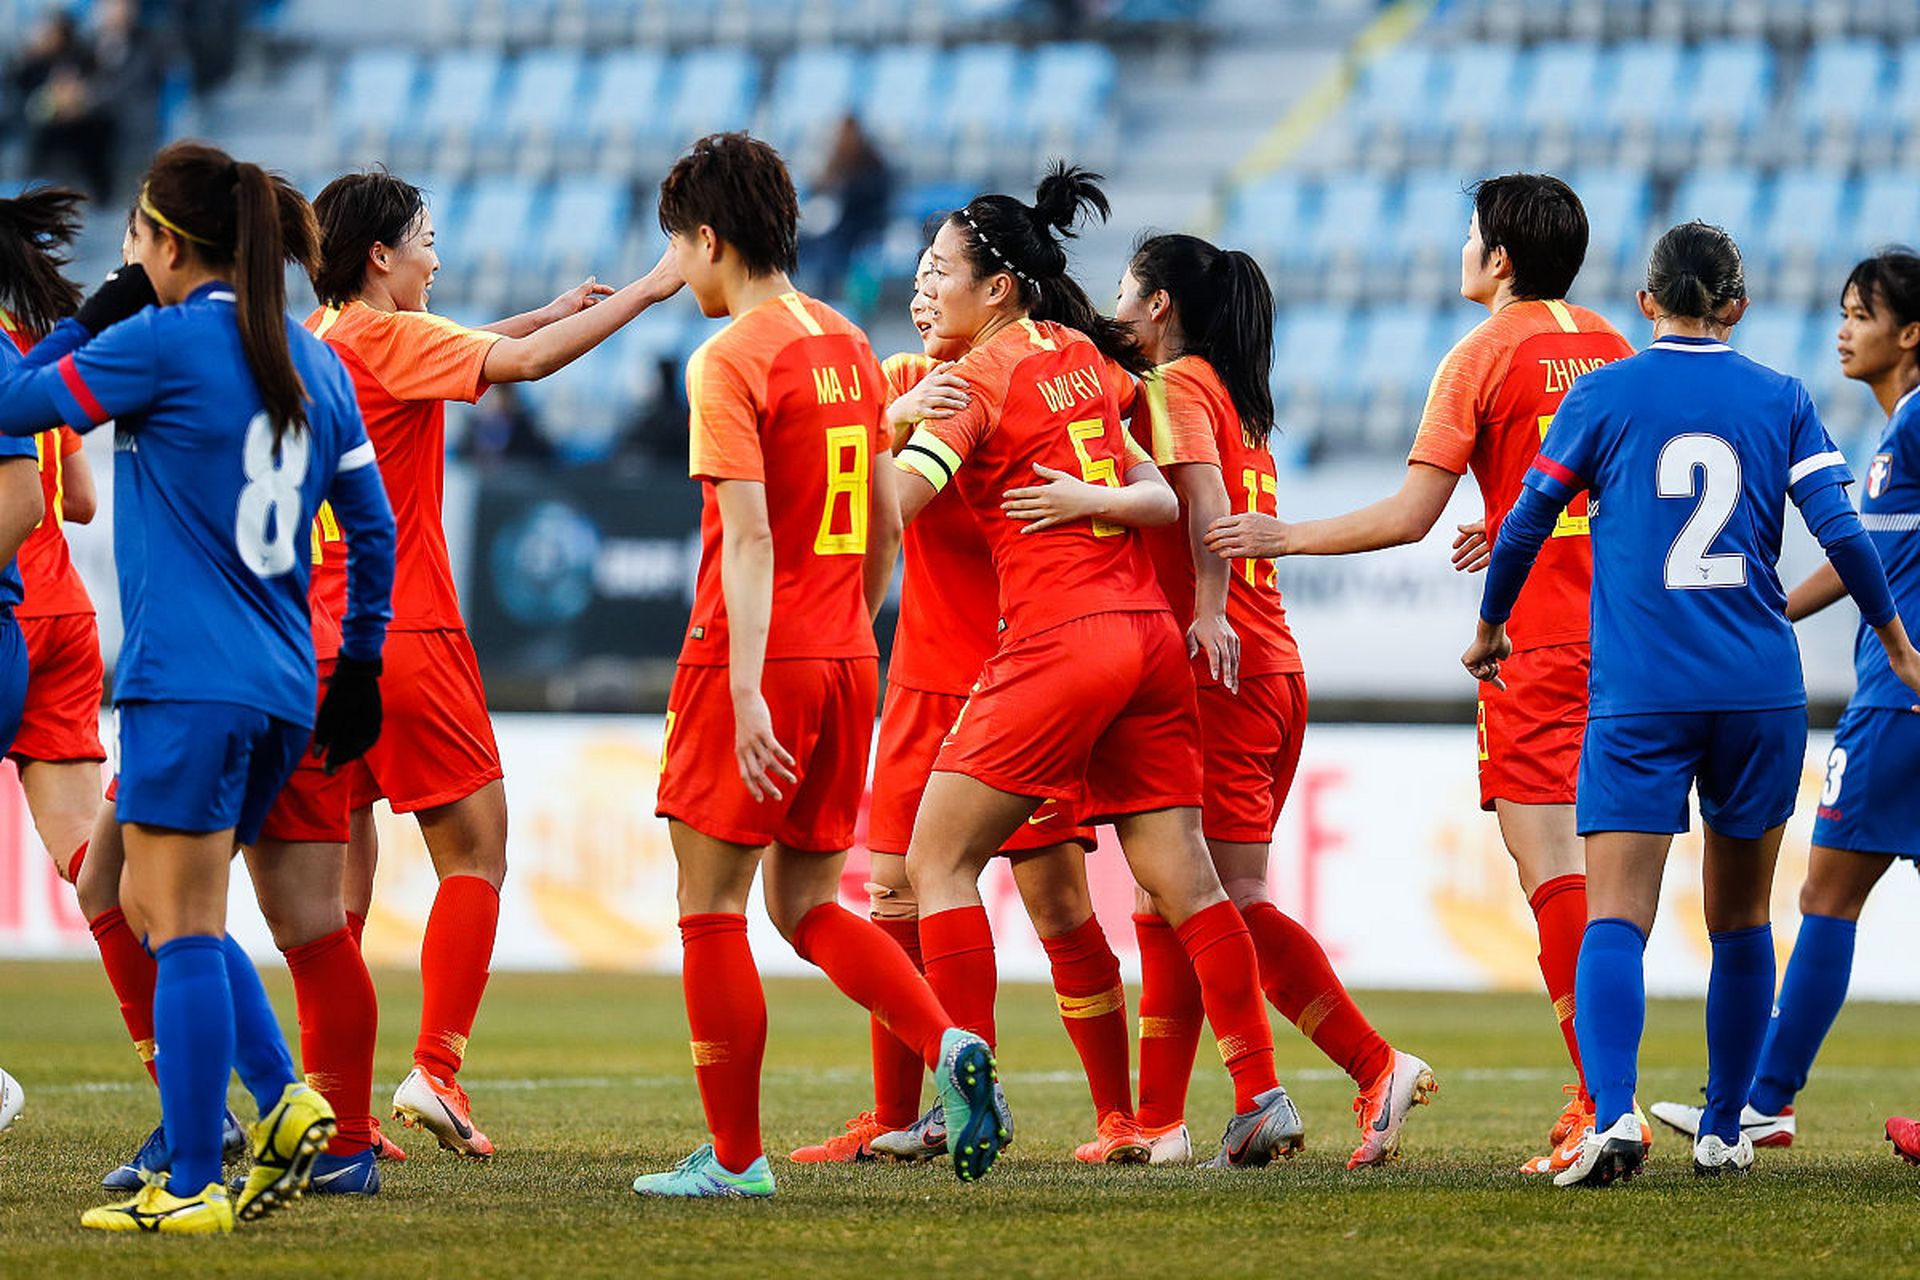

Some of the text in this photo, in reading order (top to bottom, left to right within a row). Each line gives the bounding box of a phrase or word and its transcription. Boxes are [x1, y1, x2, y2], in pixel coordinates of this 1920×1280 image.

[812, 364, 862, 404] MA J
[1036, 364, 1104, 413] WU HY
[235, 409, 311, 579] 8
[813, 424, 868, 555] 8
[1066, 417, 1128, 538] 5
[1655, 432, 1748, 590] 2
[1821, 747, 1848, 806] 3
